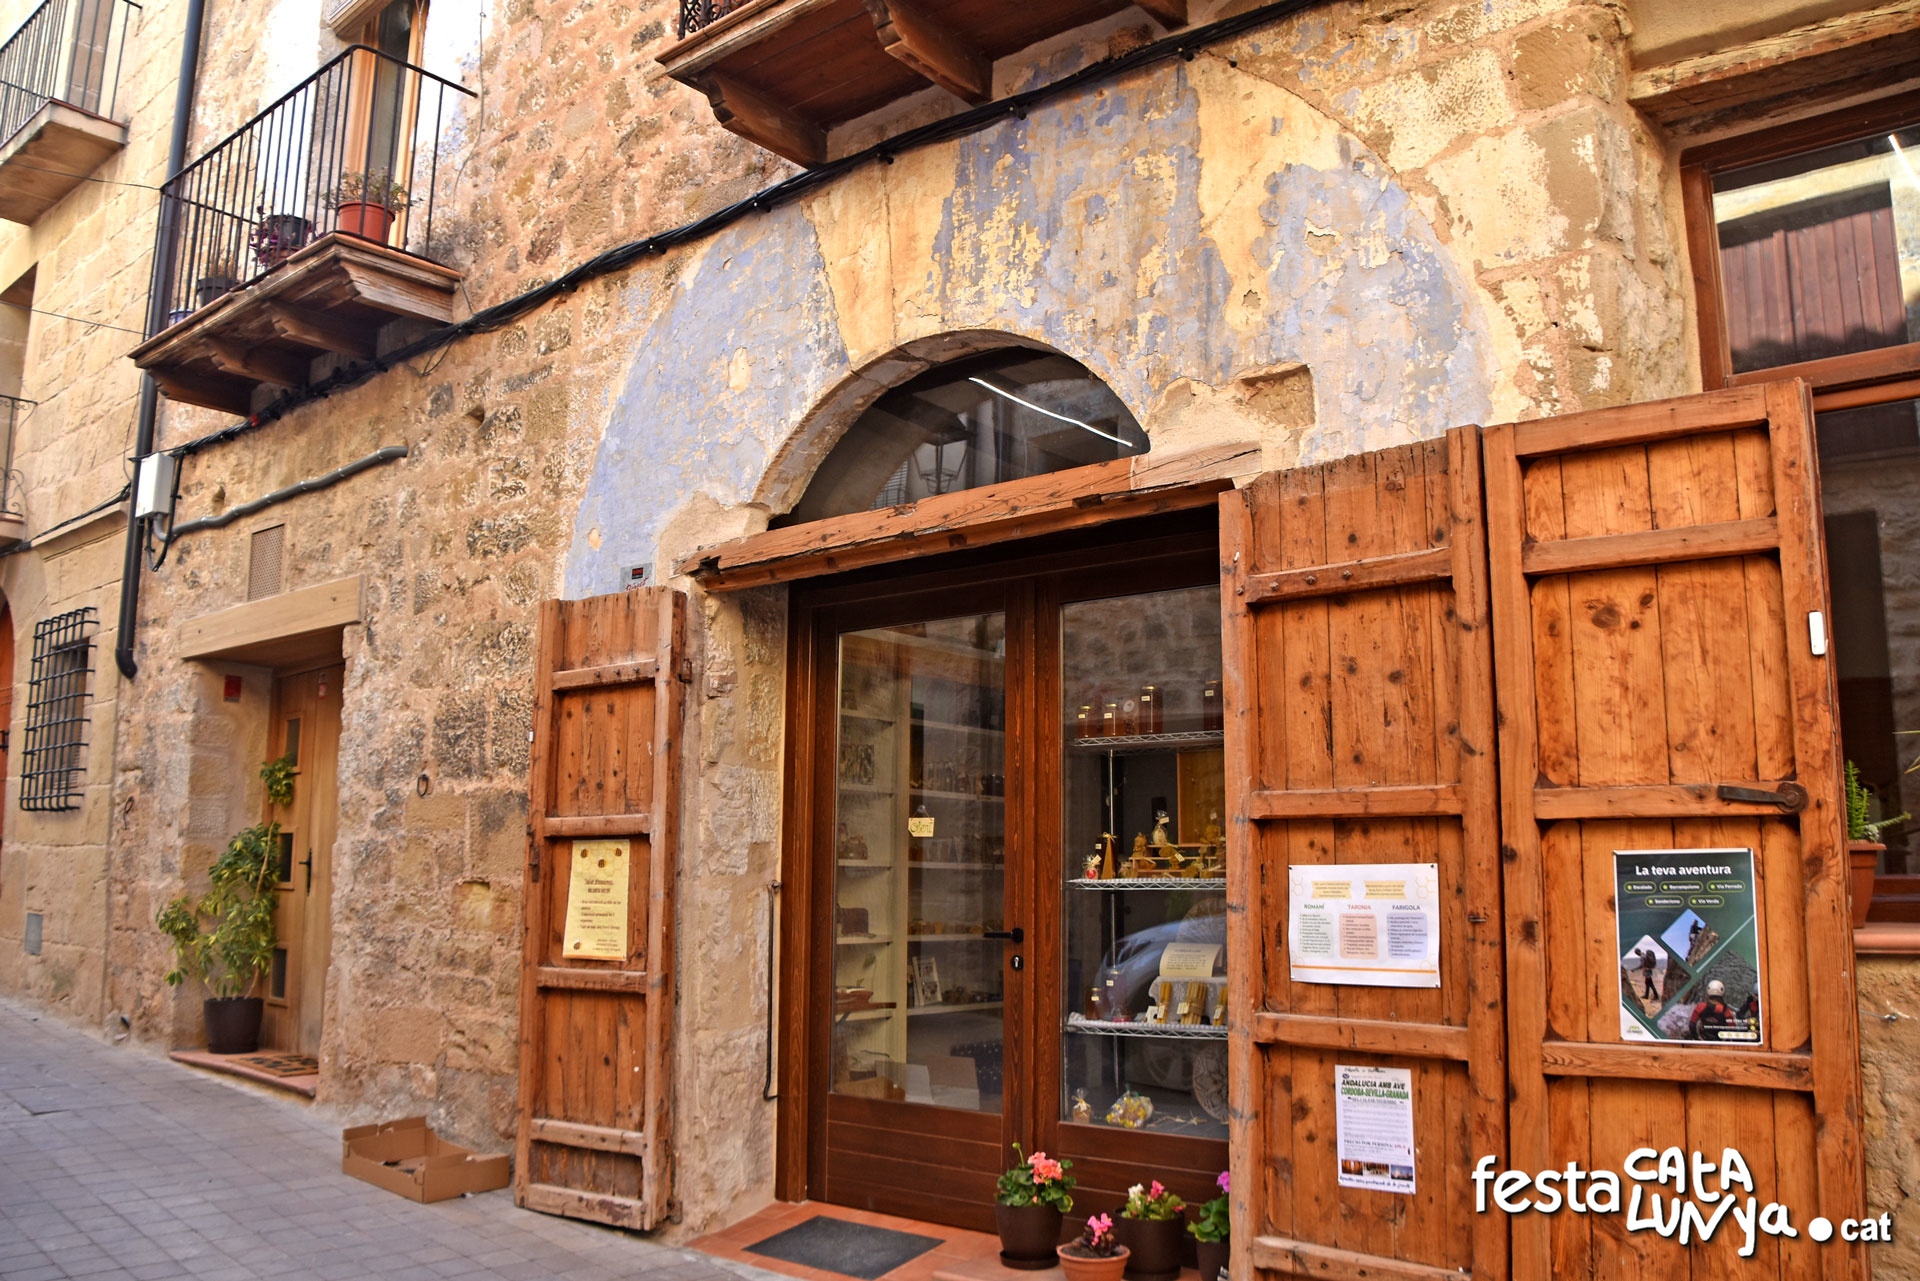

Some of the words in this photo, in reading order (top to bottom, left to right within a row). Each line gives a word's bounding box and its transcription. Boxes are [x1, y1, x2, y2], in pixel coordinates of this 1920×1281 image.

[1635, 865, 1649, 876] La
[1651, 865, 1677, 876] teva
[1679, 865, 1732, 875] aventura
[1393, 1082, 1406, 1090] AVE
